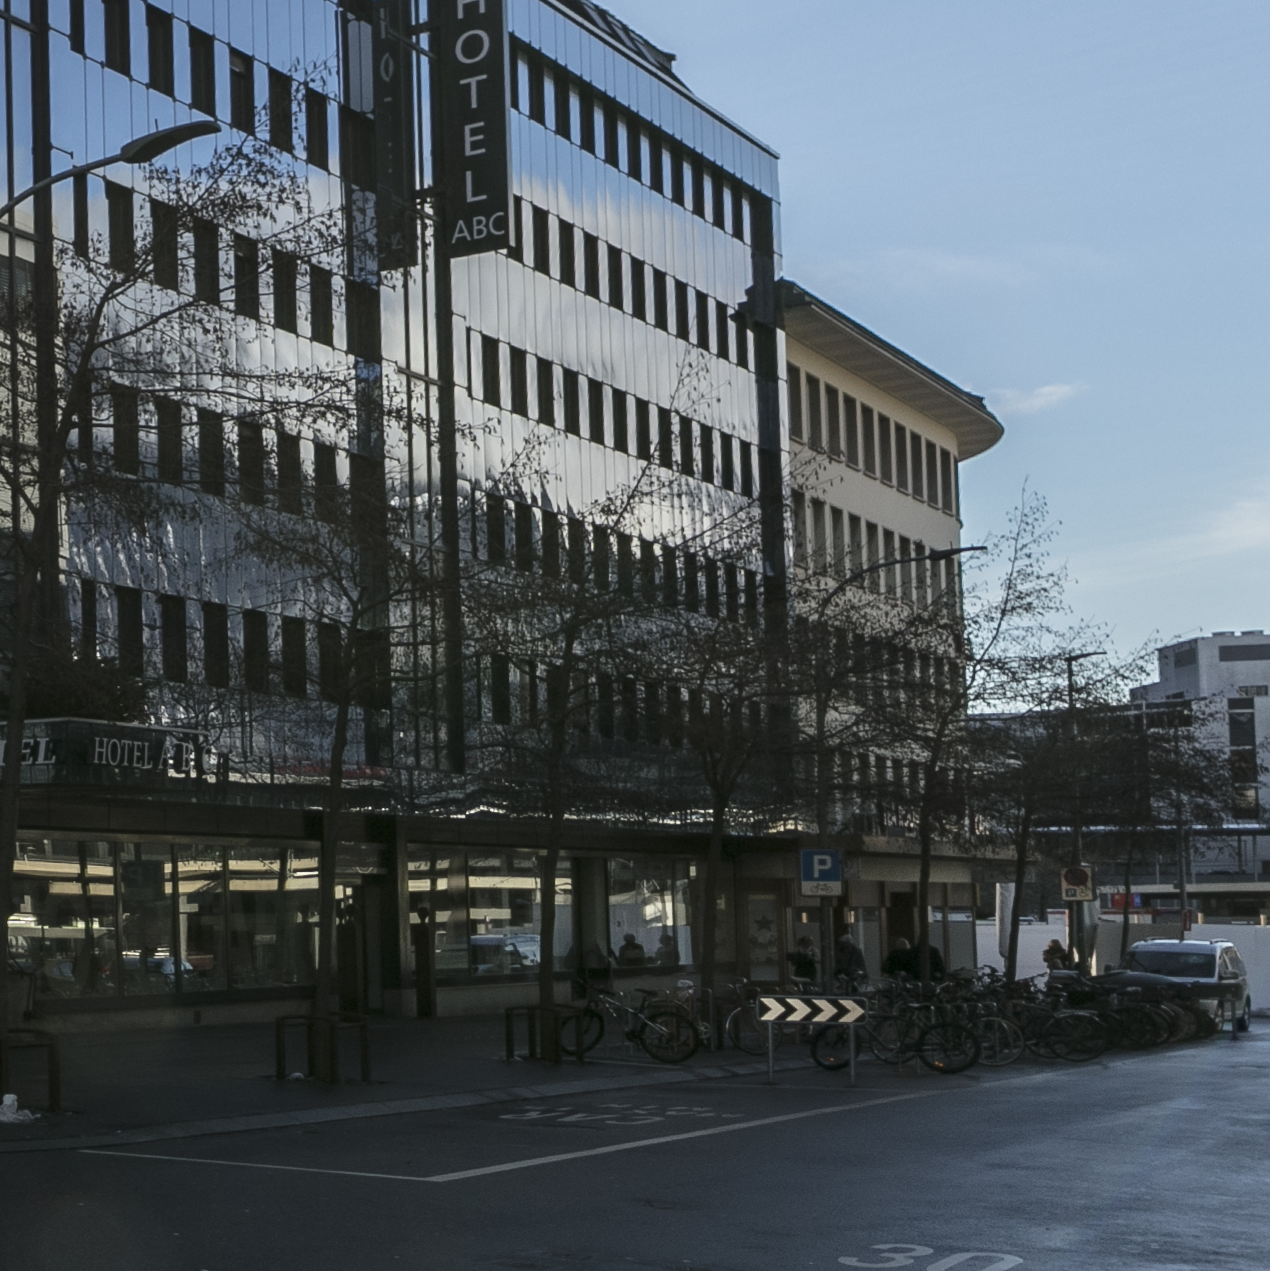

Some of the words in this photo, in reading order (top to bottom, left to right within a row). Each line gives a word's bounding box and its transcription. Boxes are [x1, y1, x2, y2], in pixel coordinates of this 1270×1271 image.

[451, 211, 506, 244] ABC
[93, 736, 153, 770] HOTEL
[813, 854, 833, 879] P
[838, 1243, 1025, 1271] 30
